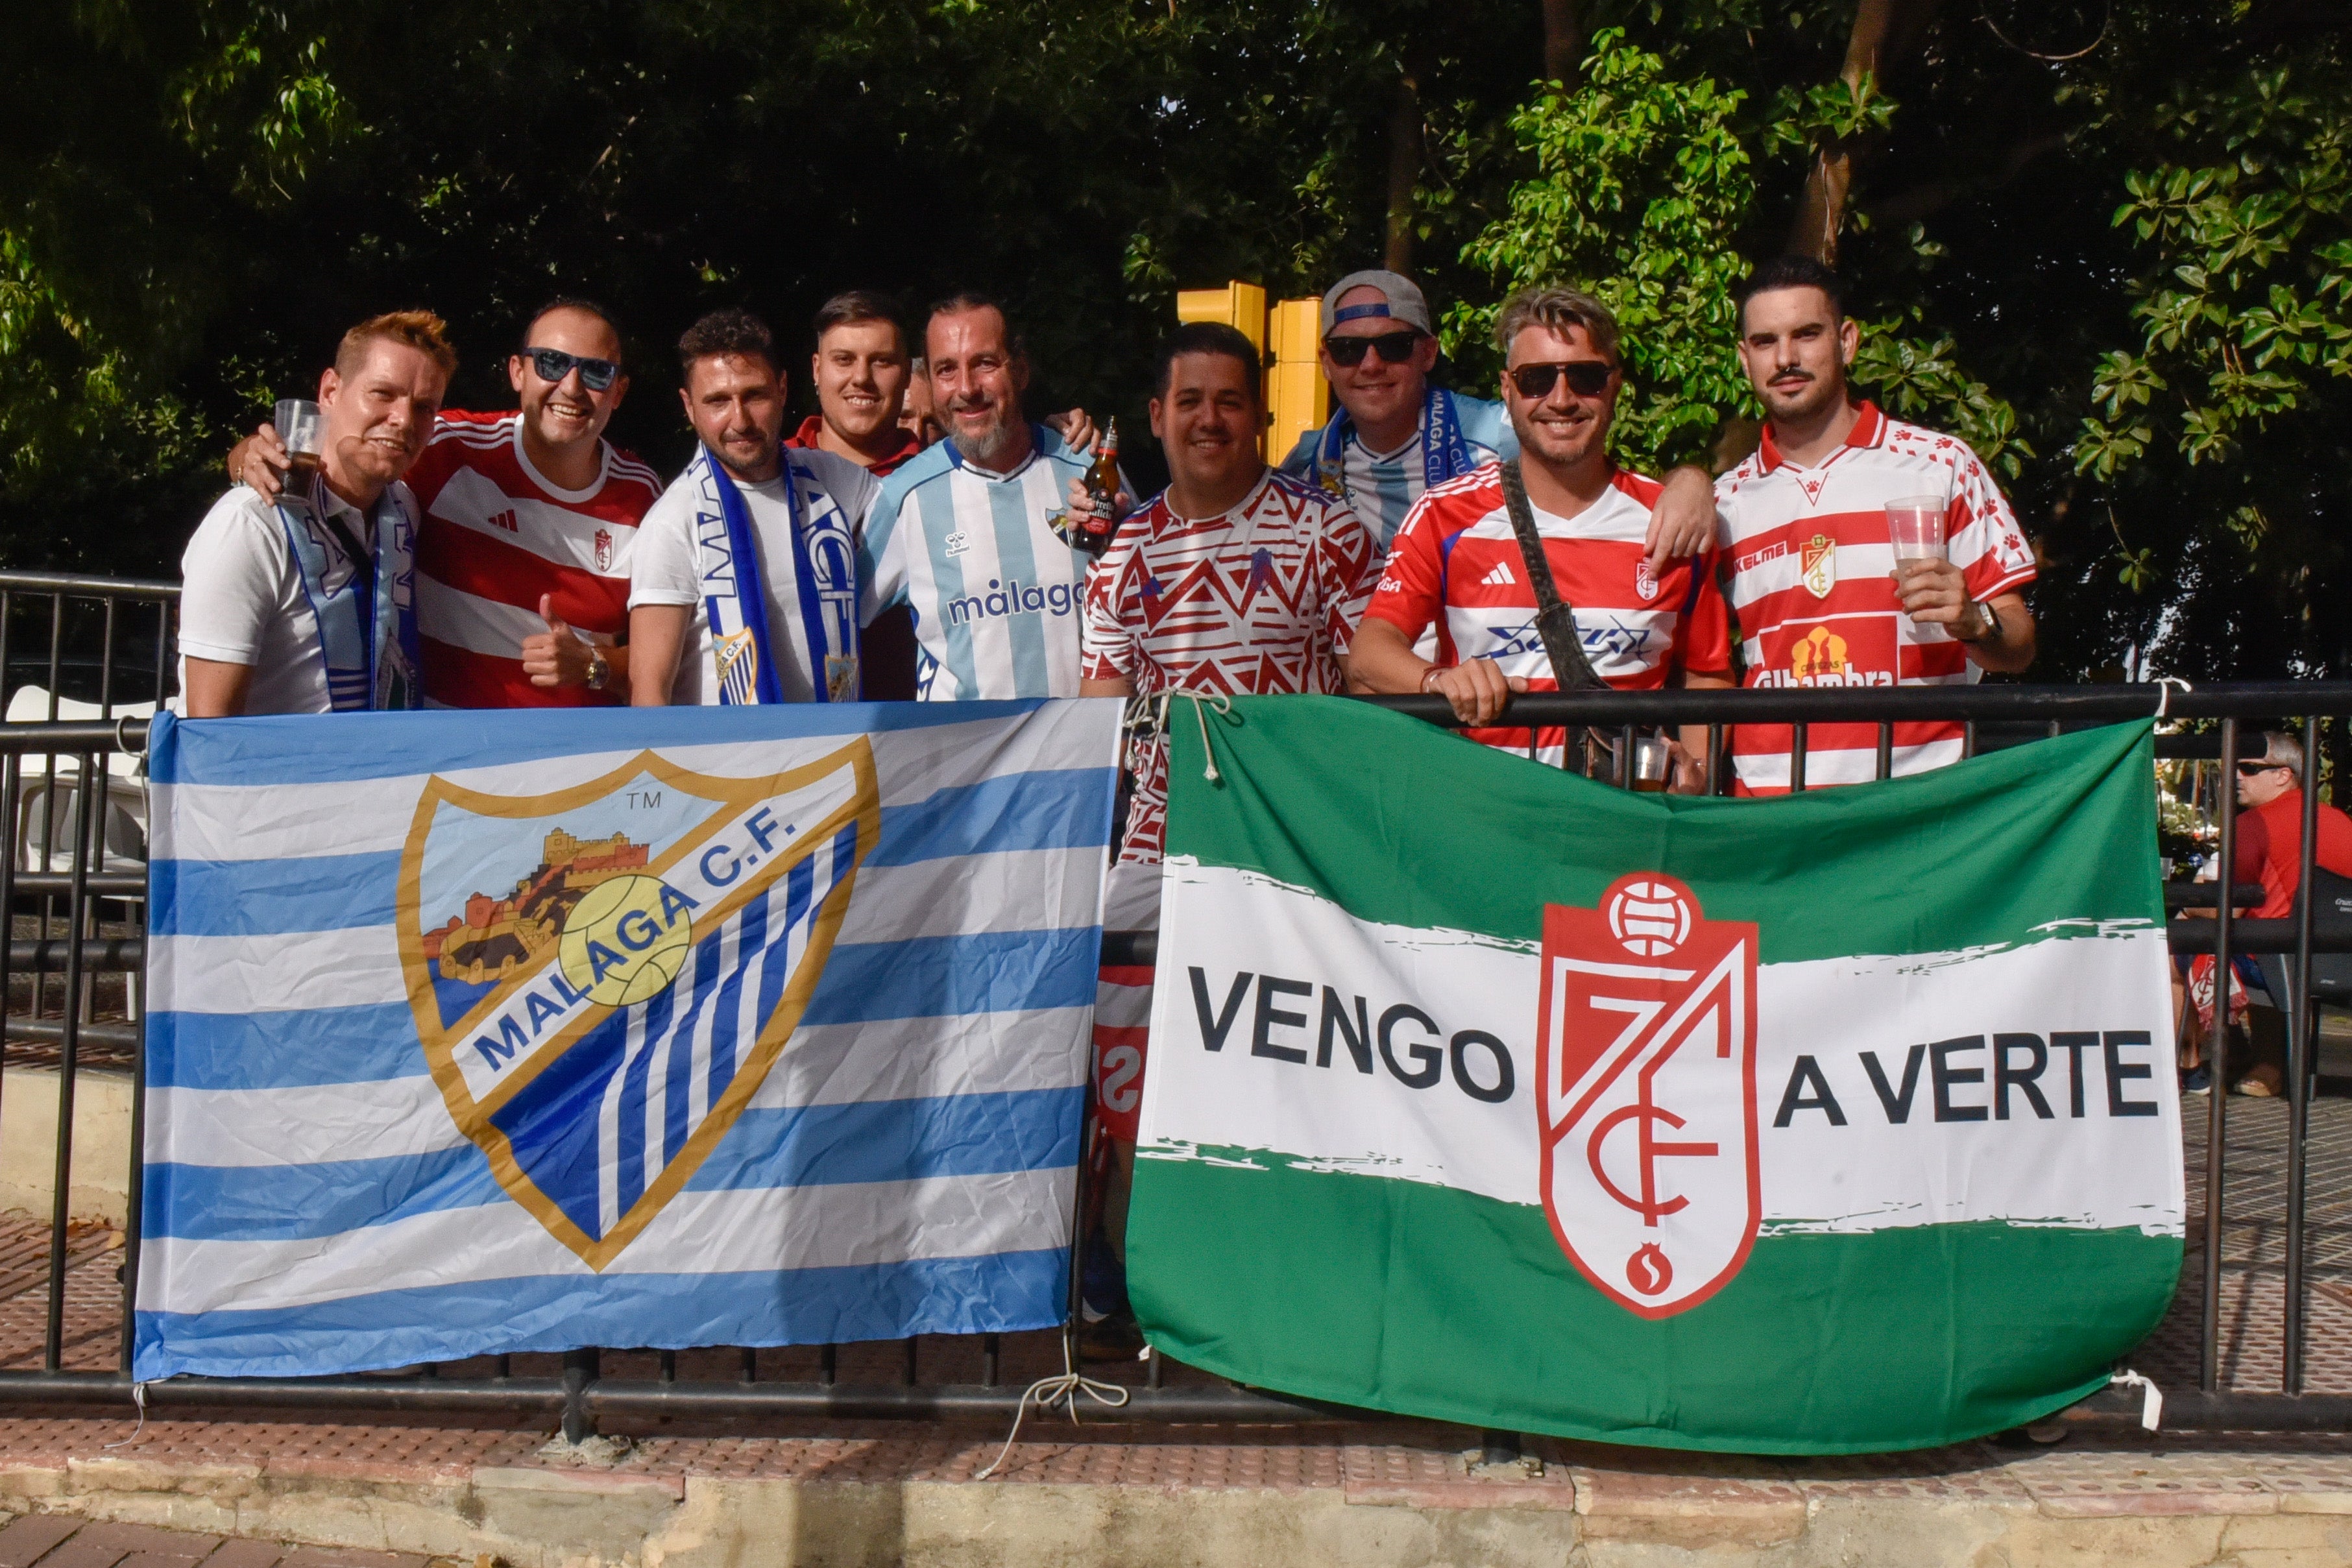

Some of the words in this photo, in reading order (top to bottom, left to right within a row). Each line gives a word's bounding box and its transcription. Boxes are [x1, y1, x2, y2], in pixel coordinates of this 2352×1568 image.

[1428, 455, 1441, 486] CLU
[1449, 448, 1468, 476] CLU
[1734, 543, 1785, 574] KELME
[626, 791, 661, 810] TM
[473, 886, 700, 1071] MALAGA
[699, 806, 797, 889] C.F.
[1187, 965, 1515, 1104] VENGO
[1773, 1055, 1848, 1128] A
[1858, 1030, 2159, 1124] VERTE
